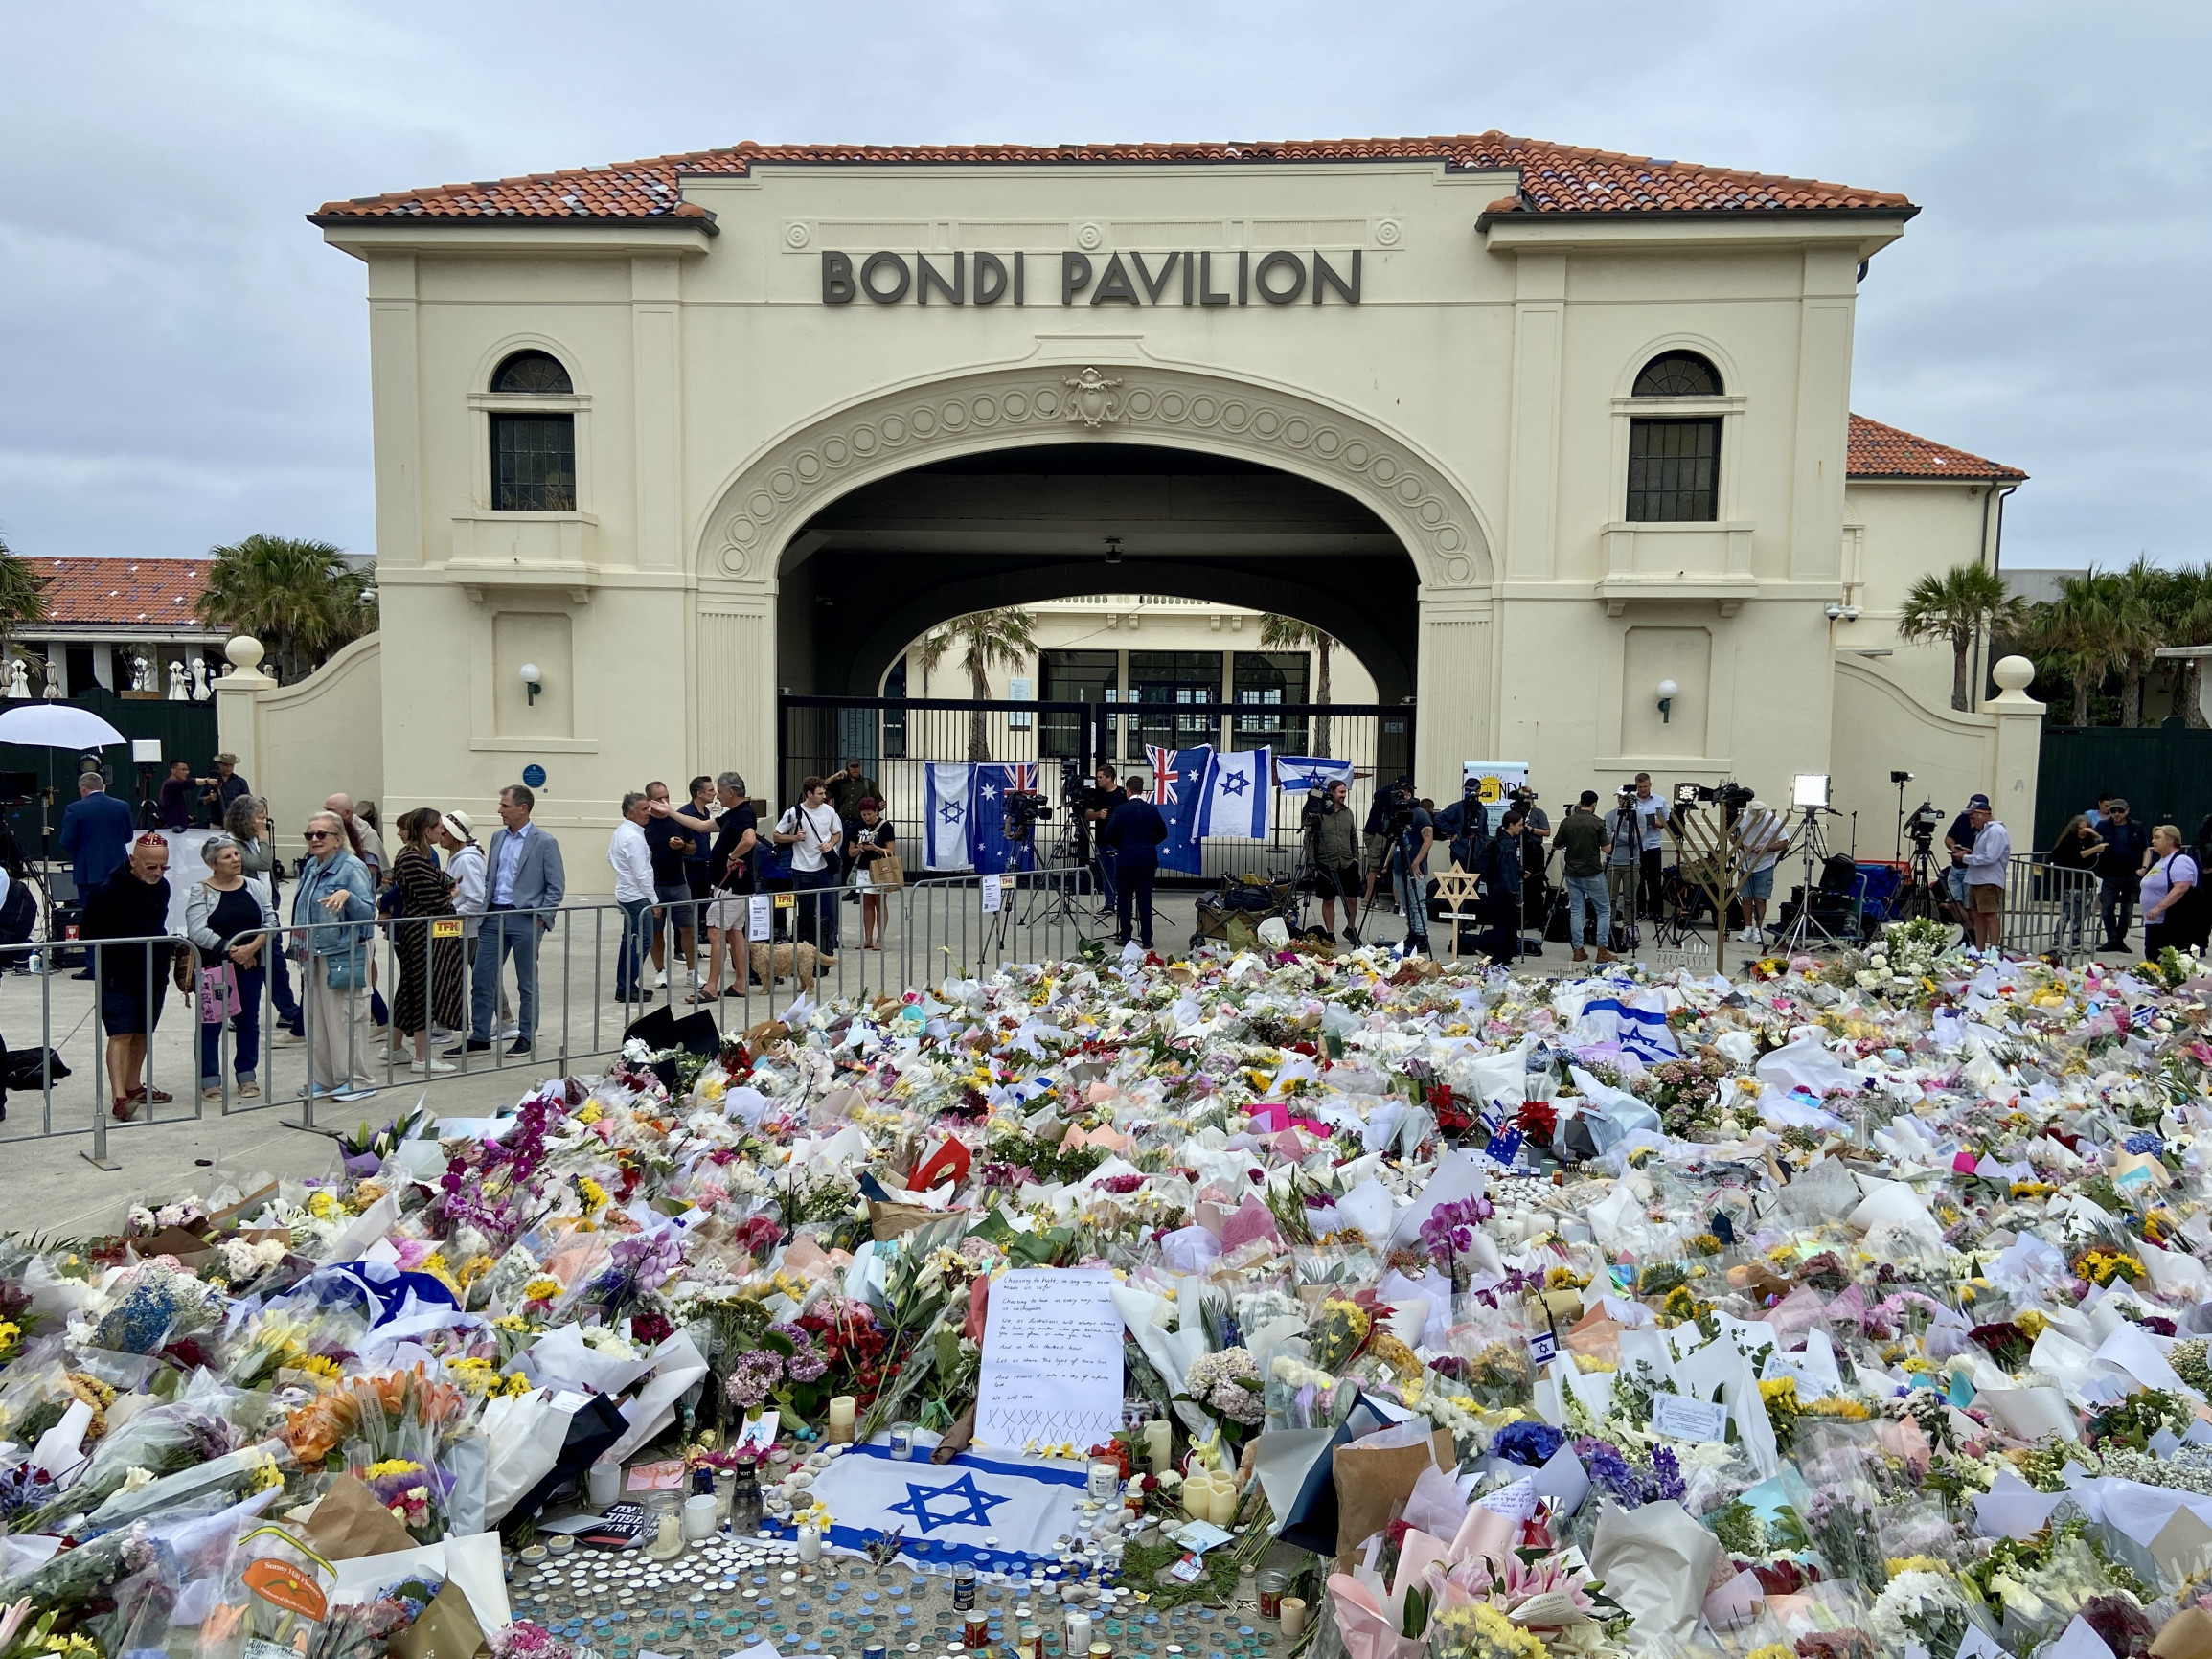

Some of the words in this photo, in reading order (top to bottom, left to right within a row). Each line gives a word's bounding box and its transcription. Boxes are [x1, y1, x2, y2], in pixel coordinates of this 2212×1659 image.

[822, 250, 1024, 305] BONDI
[1061, 249, 1361, 305] PAVILION
[437, 921, 460, 932] TFH
[264, 1561, 287, 1574] Sunny
[288, 1568, 301, 1580] Hill
[301, 1577, 322, 1599] Flowers
[1542, 1594, 1565, 1604] CLOVER
